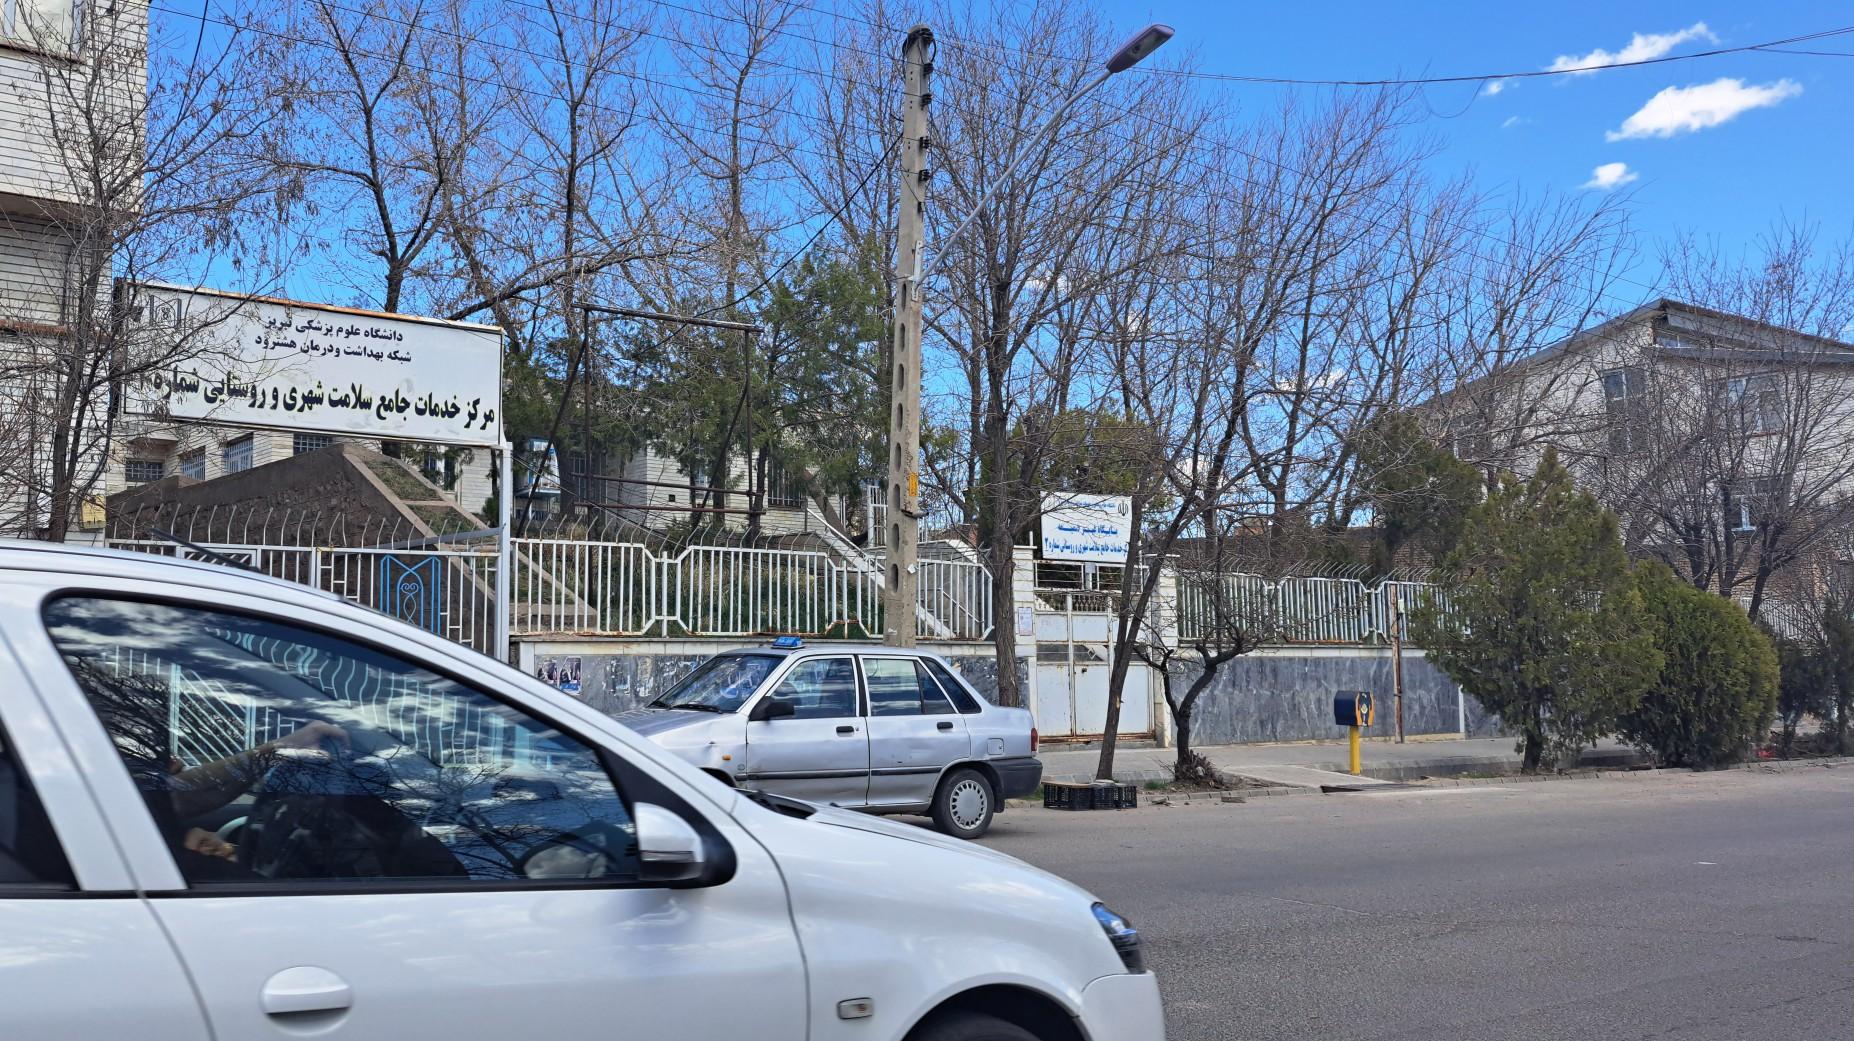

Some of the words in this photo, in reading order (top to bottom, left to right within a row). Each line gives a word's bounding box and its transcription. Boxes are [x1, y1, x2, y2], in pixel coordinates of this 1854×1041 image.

[264, 315, 292, 331] تبریز
[295, 318, 333, 337] پزشکی
[336, 324, 361, 339] علوم
[363, 326, 403, 342] دانشگاه
[255, 334, 297, 349] هشترود
[343, 344, 384, 362] بهداشت
[387, 350, 412, 364] شبکه
[153, 363, 200, 400] شماره
[203, 370, 266, 409] روستایی
[269, 386, 279, 410] و
[282, 379, 325, 413] شهری
[328, 382, 373, 410] سلامت
[375, 387, 411, 422] جامع
[414, 392, 461, 419] خدمات
[463, 397, 495, 430] مرکز
